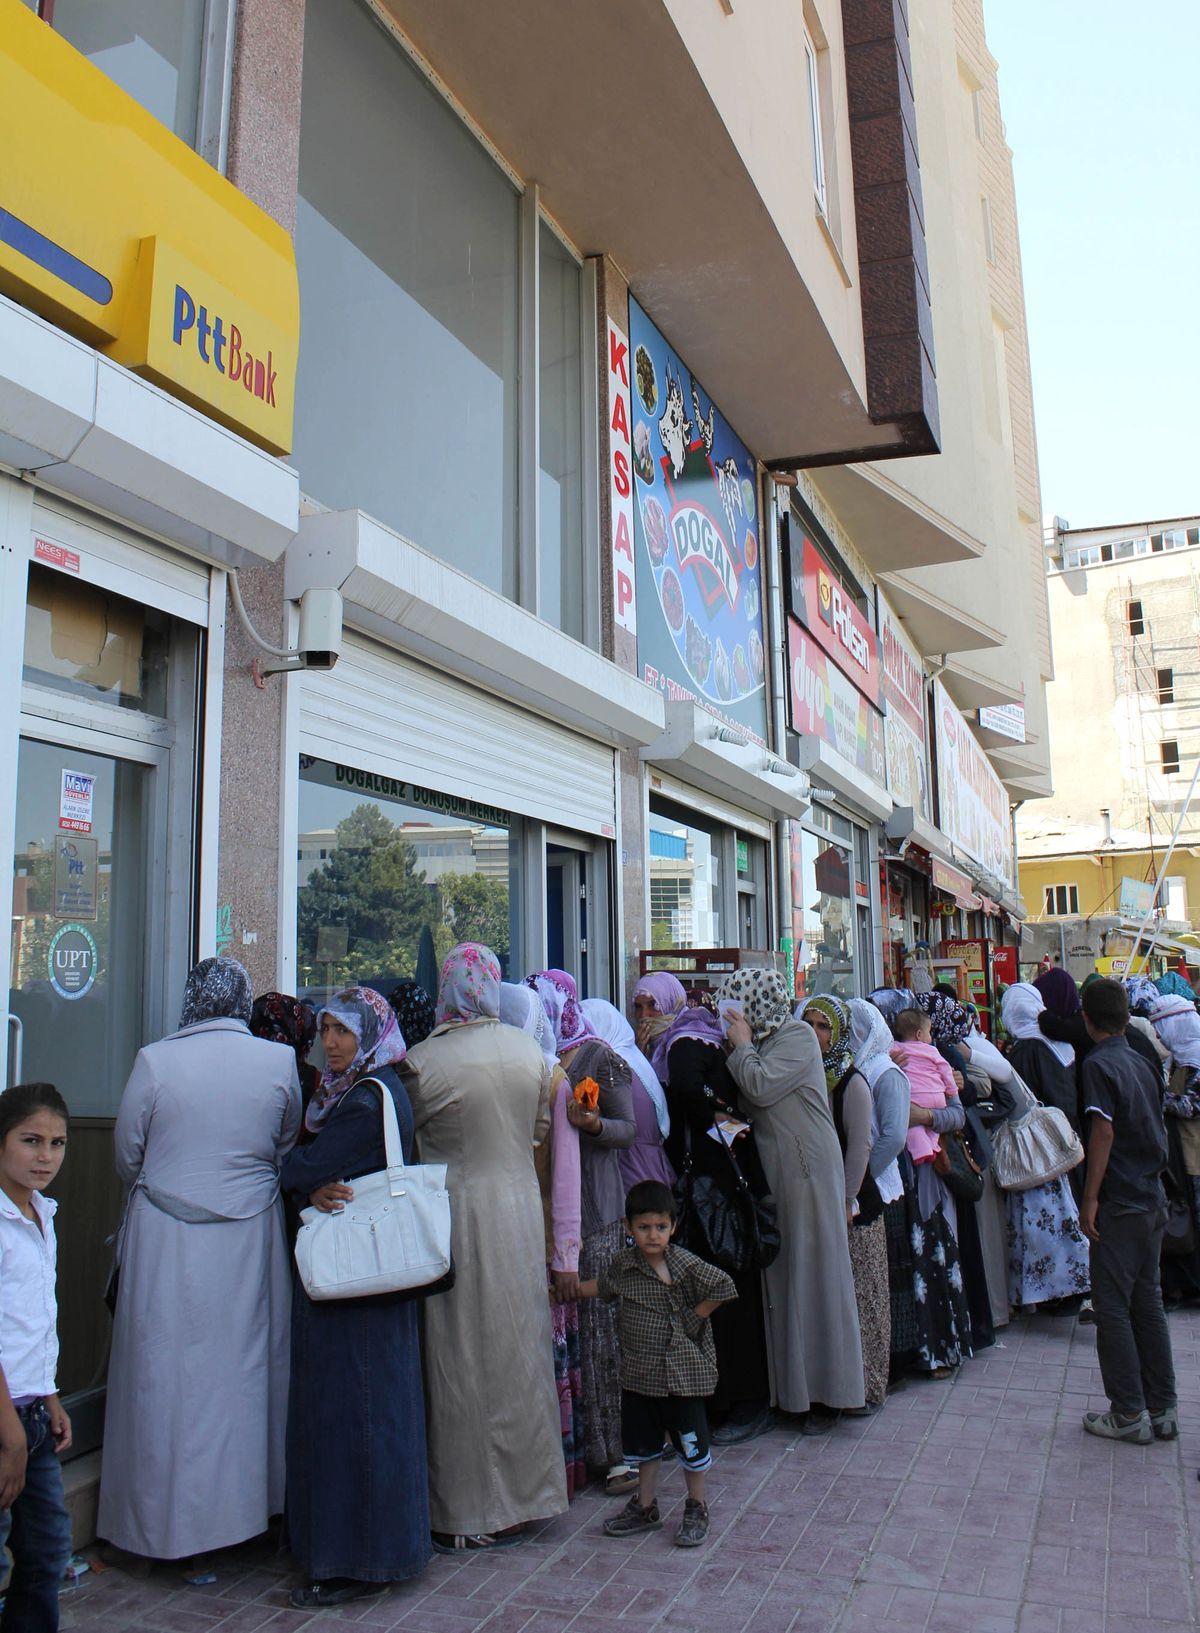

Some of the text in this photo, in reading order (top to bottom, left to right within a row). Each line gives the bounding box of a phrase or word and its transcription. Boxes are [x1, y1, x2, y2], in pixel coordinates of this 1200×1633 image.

[172, 284, 277, 408] PttBank
[610, 330, 633, 617] KASAP
[794, 637, 826, 732] dyo
[66, 775, 92, 792] Mavi
[69, 859, 84, 875] Ptt
[55, 950, 91, 968] UPT
